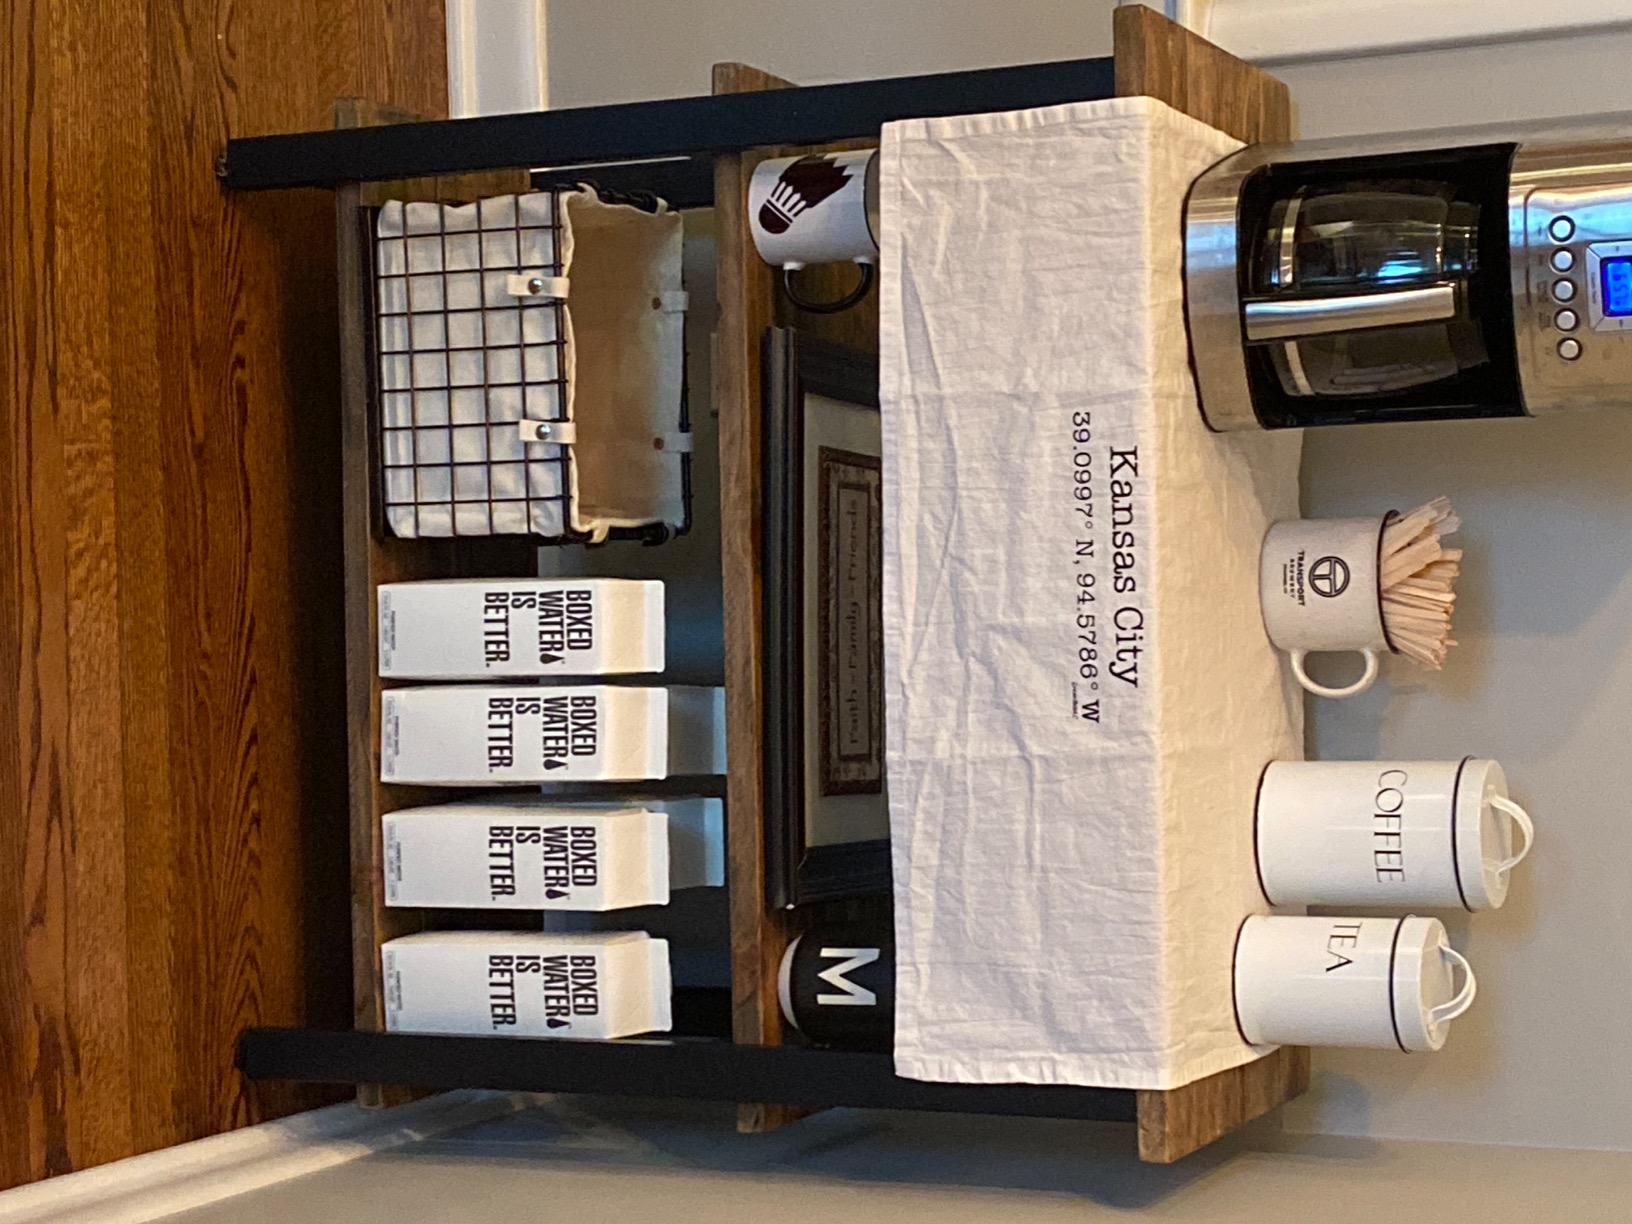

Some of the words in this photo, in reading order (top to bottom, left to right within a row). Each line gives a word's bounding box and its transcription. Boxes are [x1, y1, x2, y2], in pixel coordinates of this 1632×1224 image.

[1072, 411, 1093, 530] 39.0997°
[1109, 446, 1139, 593] Kansas
[1073, 540, 1094, 564] N,
[1297, 551, 1305, 606] TRANSPORT
[484, 592, 510, 668] BETTER.
[511, 591, 536, 609] IS
[538, 590, 565, 653] WATER
[565, 590, 593, 651] BOXED
[1076, 573, 1099, 691] 94.5786°
[1109, 607, 1144, 688] City
[488, 698, 513, 773] BETTER.
[516, 697, 540, 715] IS
[543, 696, 569, 758] WATER
[570, 696, 597, 756] BOXED
[1081, 700, 1100, 724] W
[515, 826, 541, 844] IS
[544, 826, 569, 888] WATER
[570, 826, 598, 887] BOXED
[1373, 769, 1408, 883] COFFEE
[488, 826, 516, 902] BETTER.
[516, 955, 541, 973] IS
[816, 946, 881, 1008] M
[1325, 921, 1362, 973] TEA
[488, 955, 516, 1030] BETTER.
[543, 955, 570, 1018] WATER
[570, 956, 598, 1016] BOXED
